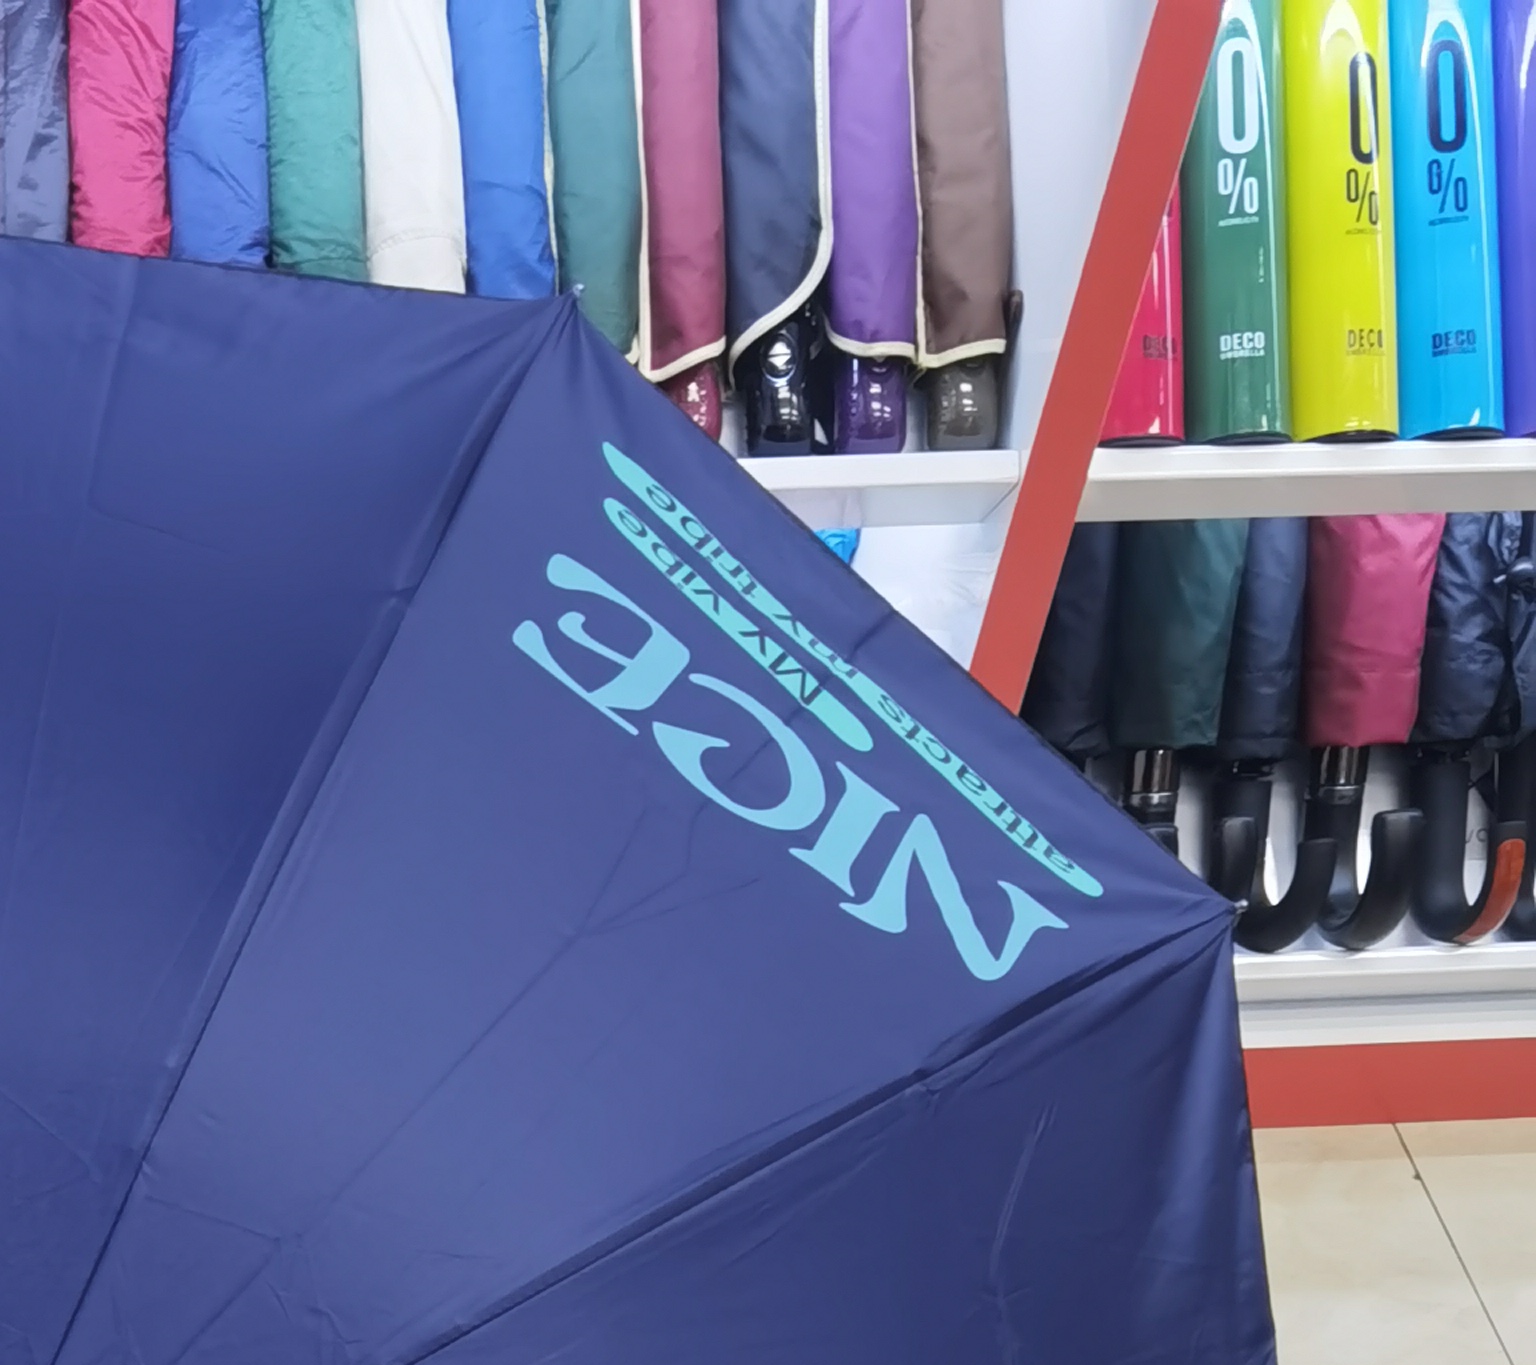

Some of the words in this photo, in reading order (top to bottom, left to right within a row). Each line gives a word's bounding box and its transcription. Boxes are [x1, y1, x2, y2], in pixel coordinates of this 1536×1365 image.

[1216, 36, 1260, 154] 0
[1426, 39, 1467, 154] 0
[1219, 331, 1265, 351] DECO
[1431, 329, 1477, 350] DECO
[617, 509, 721, 616] vibe
[645, 483, 758, 599] tribe
[737, 630, 824, 706] My
[771, 612, 859, 680] my
[512, 553, 1070, 981] NICE
[877, 693, 1076, 875] attracts
